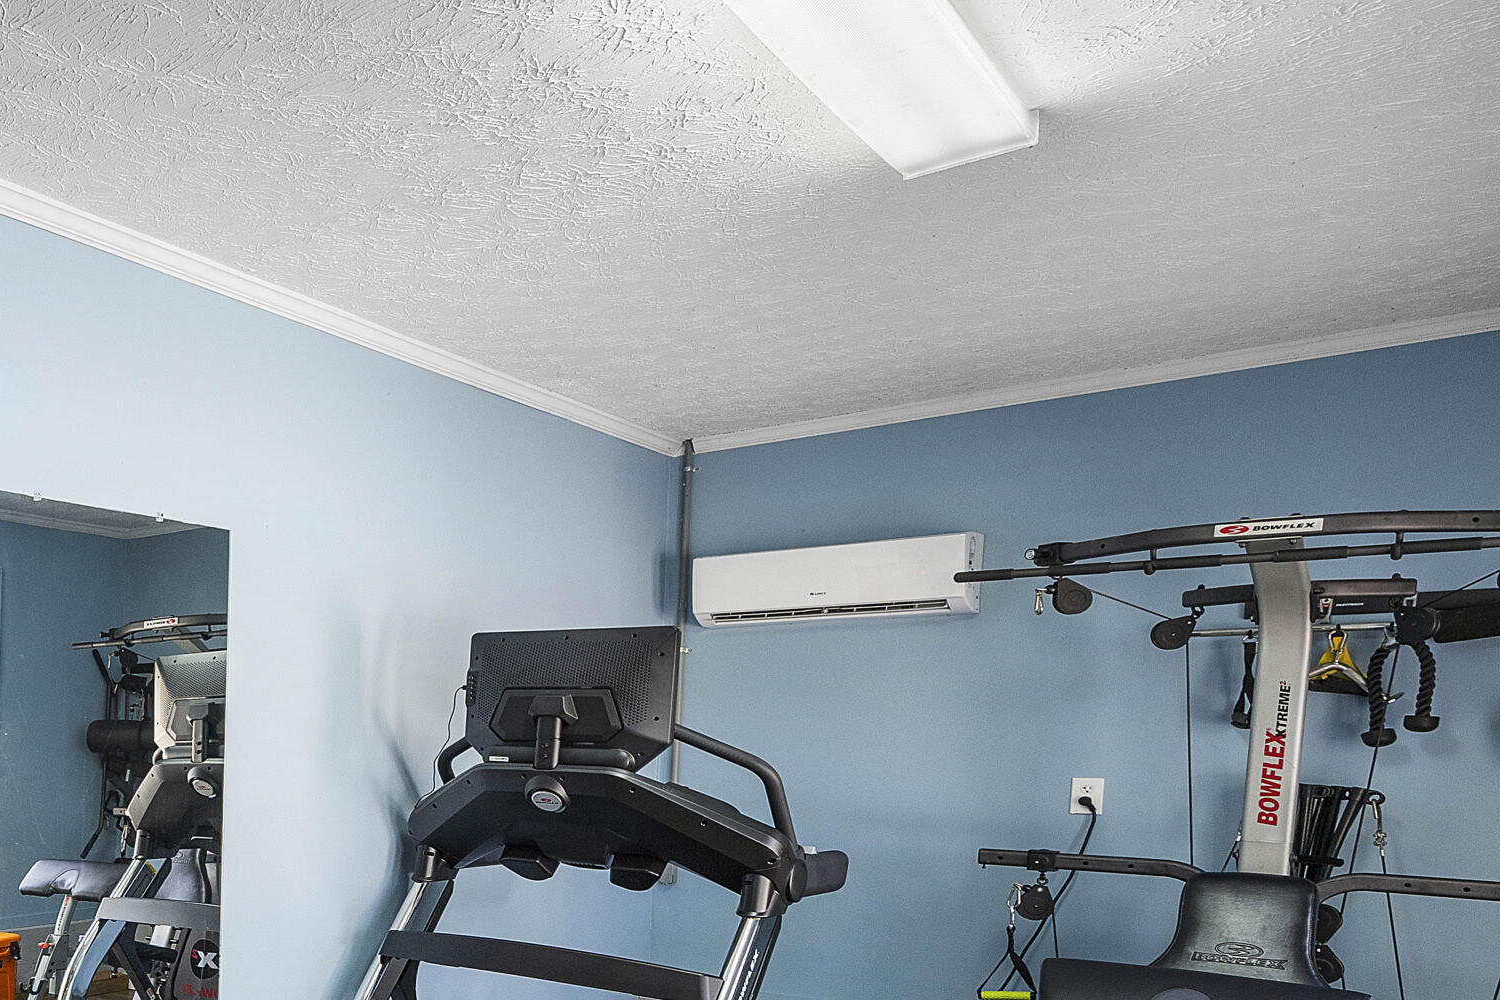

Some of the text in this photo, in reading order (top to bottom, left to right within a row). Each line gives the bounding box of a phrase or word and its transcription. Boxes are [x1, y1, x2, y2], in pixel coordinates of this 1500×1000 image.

[1252, 521, 1316, 532] BOWFLEX
[1256, 728, 1287, 827] BOWFLEX
[1190, 951, 1288, 970] BOWFLEX
